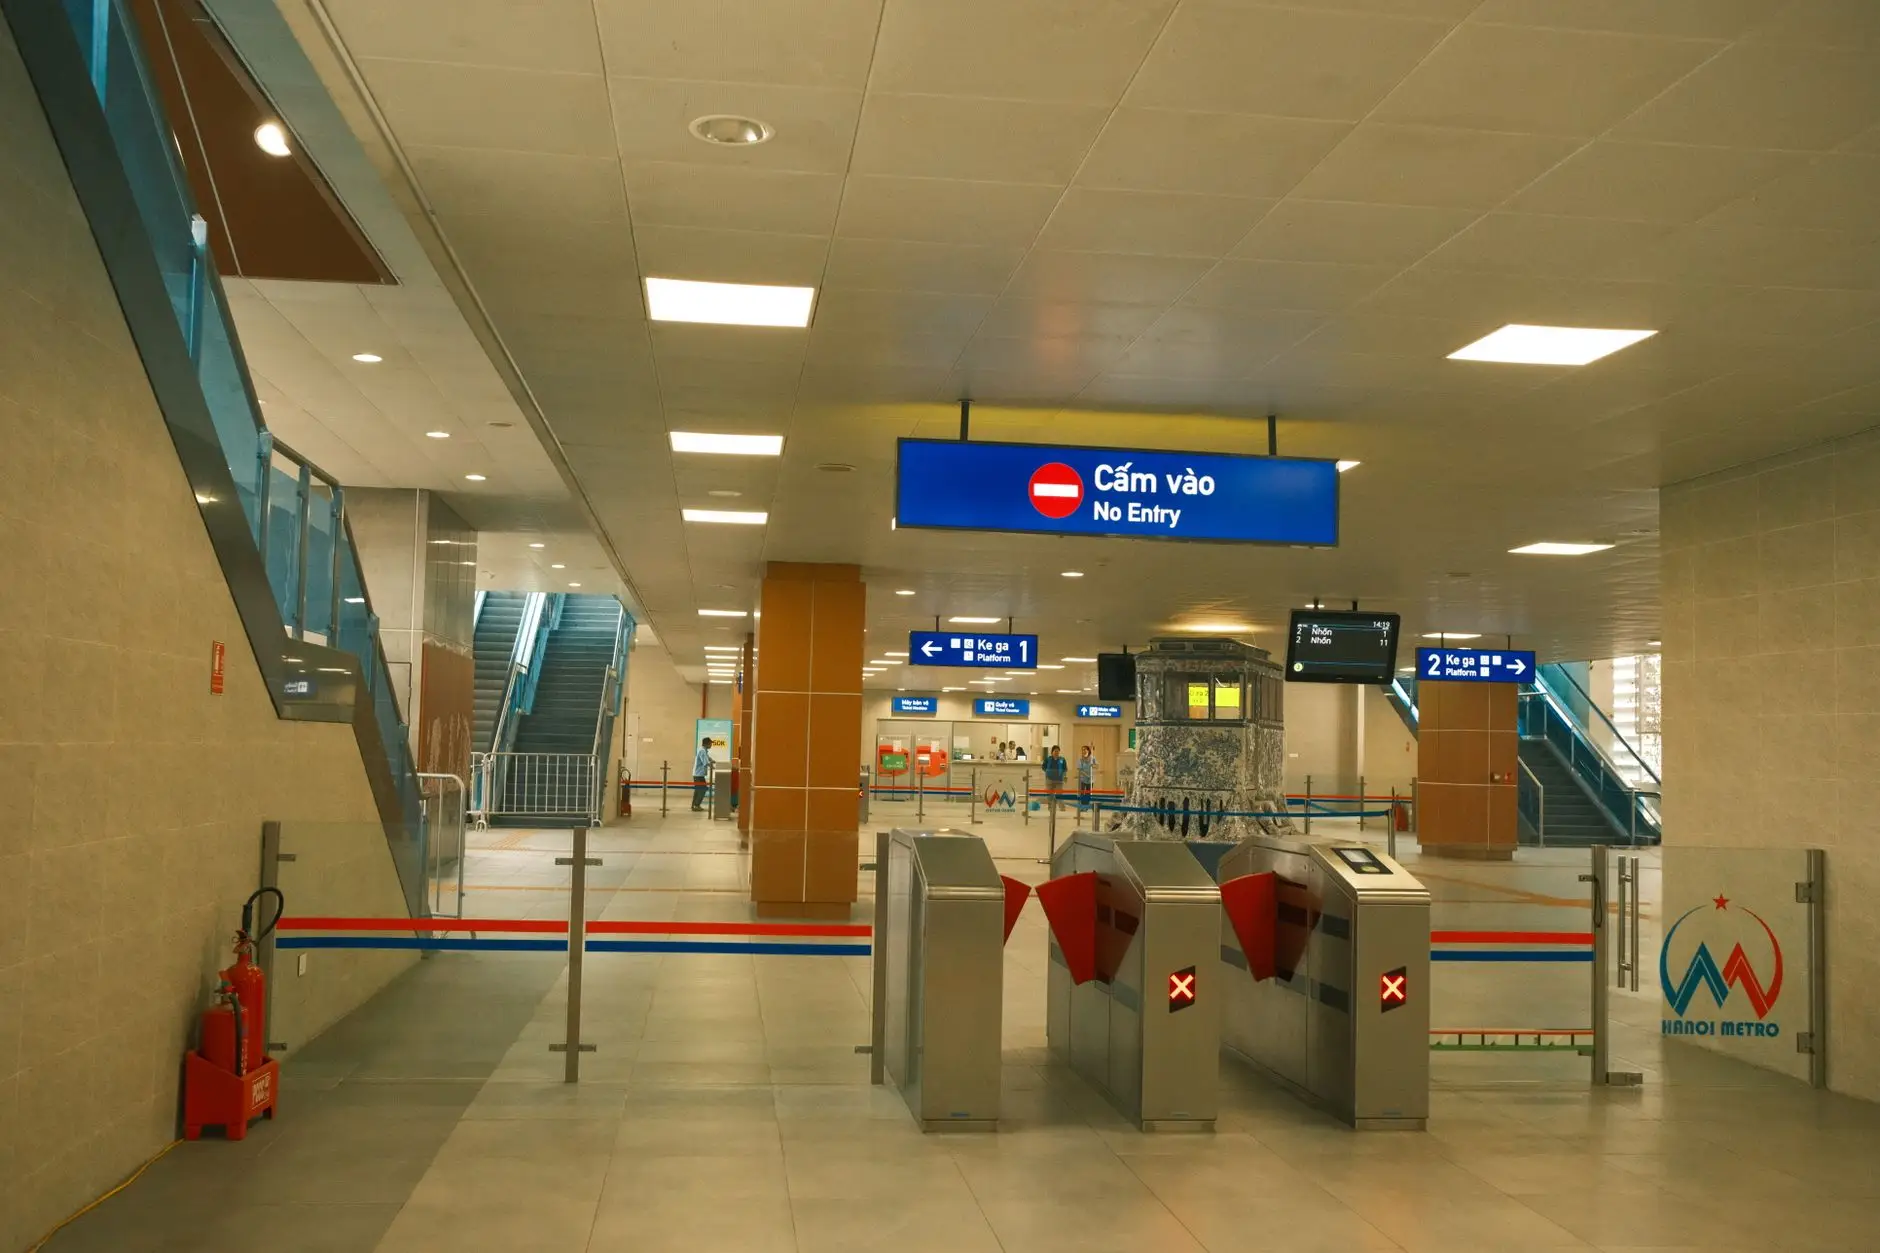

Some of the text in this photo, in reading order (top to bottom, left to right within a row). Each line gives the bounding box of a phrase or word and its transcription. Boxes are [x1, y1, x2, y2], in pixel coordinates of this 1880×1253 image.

[1094, 461, 1215, 496] Cấm vào
[1093, 501, 1181, 529] No Entry
[1296, 627, 1302, 635] 2
[977, 639, 1009, 653] Ke ga
[1296, 636, 1301, 644] 2
[977, 653, 1011, 662] Platform
[1019, 640, 1028, 663] 1
[1427, 653, 1441, 676] 2
[1445, 654, 1475, 668] Ke ga
[1445, 667, 1477, 677] Platform
[1661, 1019, 1780, 1037] HANOI METRO
